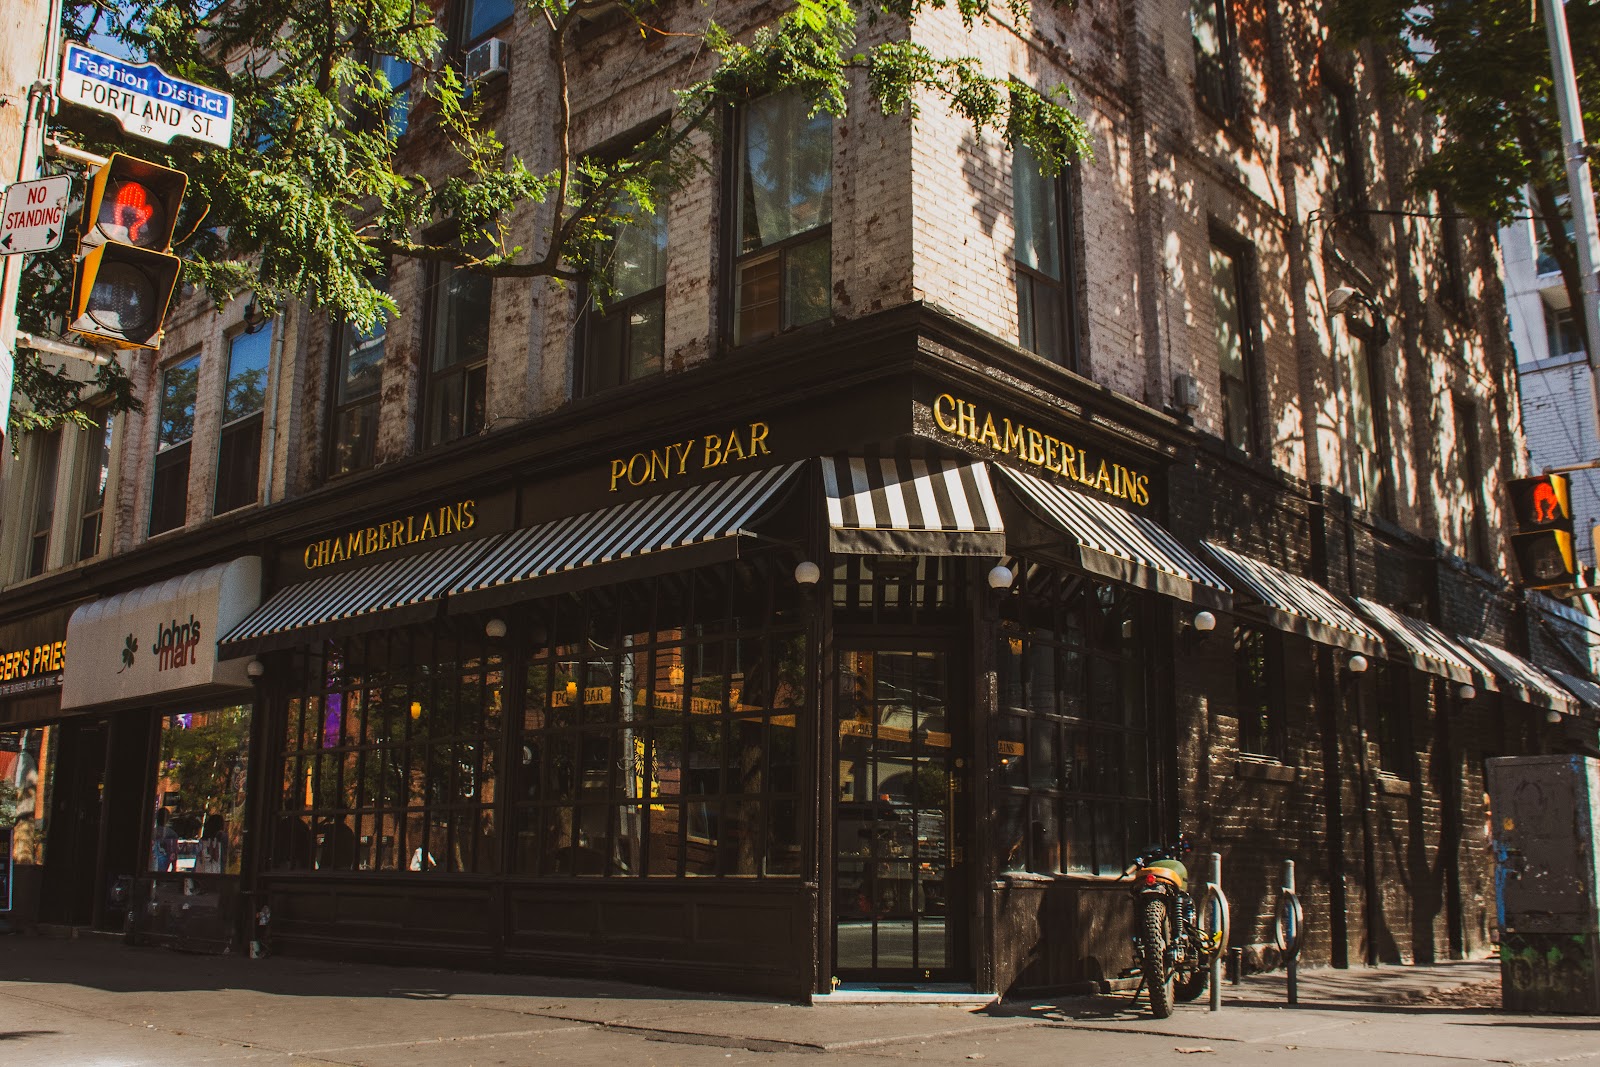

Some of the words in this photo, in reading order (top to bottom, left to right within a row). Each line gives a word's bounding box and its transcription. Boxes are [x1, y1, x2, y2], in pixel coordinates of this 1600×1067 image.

[75, 53, 148, 91] Fashion
[158, 80, 223, 114] District
[80, 79, 181, 126] PORTLAND
[191, 114, 214, 138] ST.
[139, 124, 152, 134] 87
[5, 206, 61, 229] STANDING
[27, 186, 47, 205] NO
[609, 439, 695, 492] PONY
[702, 422, 771, 469] BAR
[933, 393, 1149, 507] CHAMBERLAINS
[304, 500, 475, 570] CHAMBERLAINS
[153, 614, 200, 655] John's
[159, 640, 196, 672] mart
